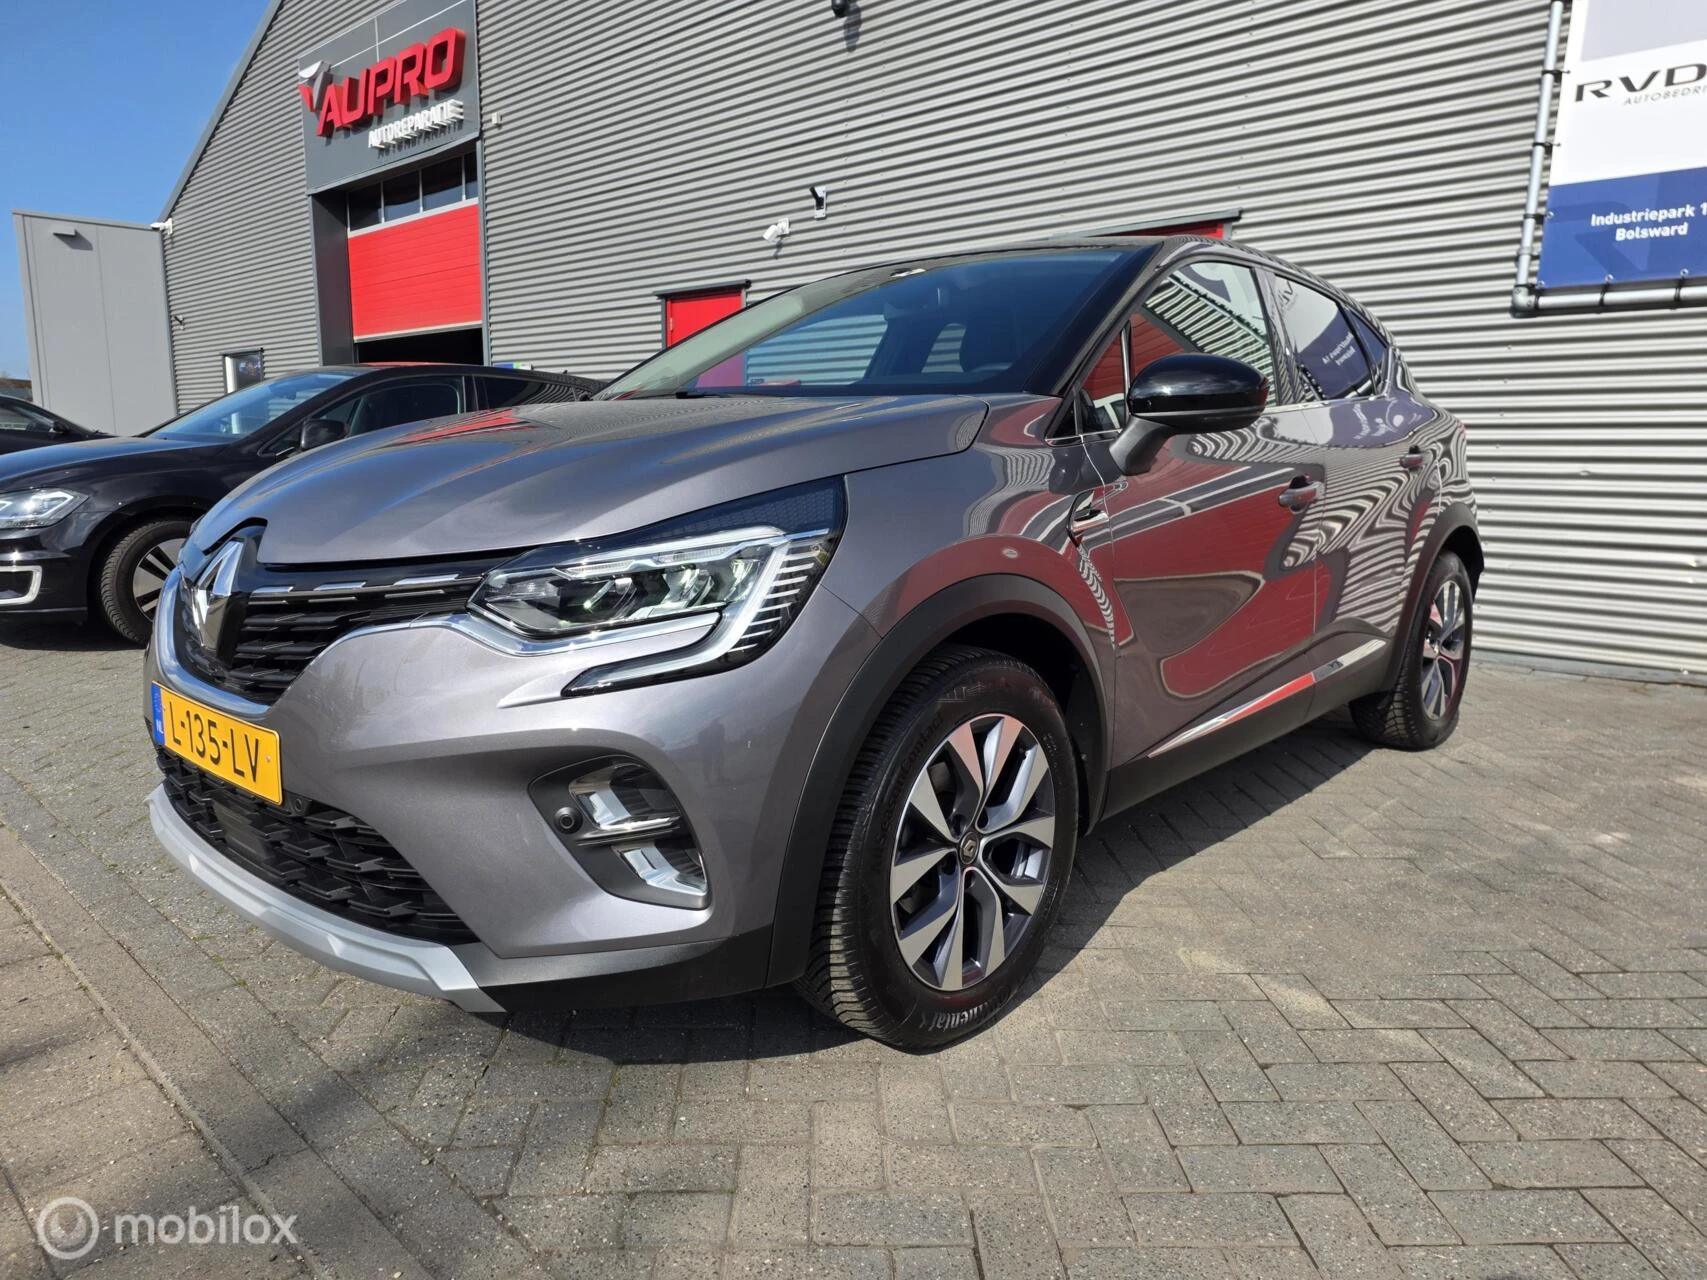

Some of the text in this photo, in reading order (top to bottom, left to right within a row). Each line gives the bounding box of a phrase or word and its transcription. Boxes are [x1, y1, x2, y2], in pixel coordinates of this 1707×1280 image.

[316, 27, 465, 136] AUPRO
[1590, 204, 1696, 228] Industriepark
[1615, 221, 1688, 241] Bolsward
[169, 701, 259, 782] L-135-LV
